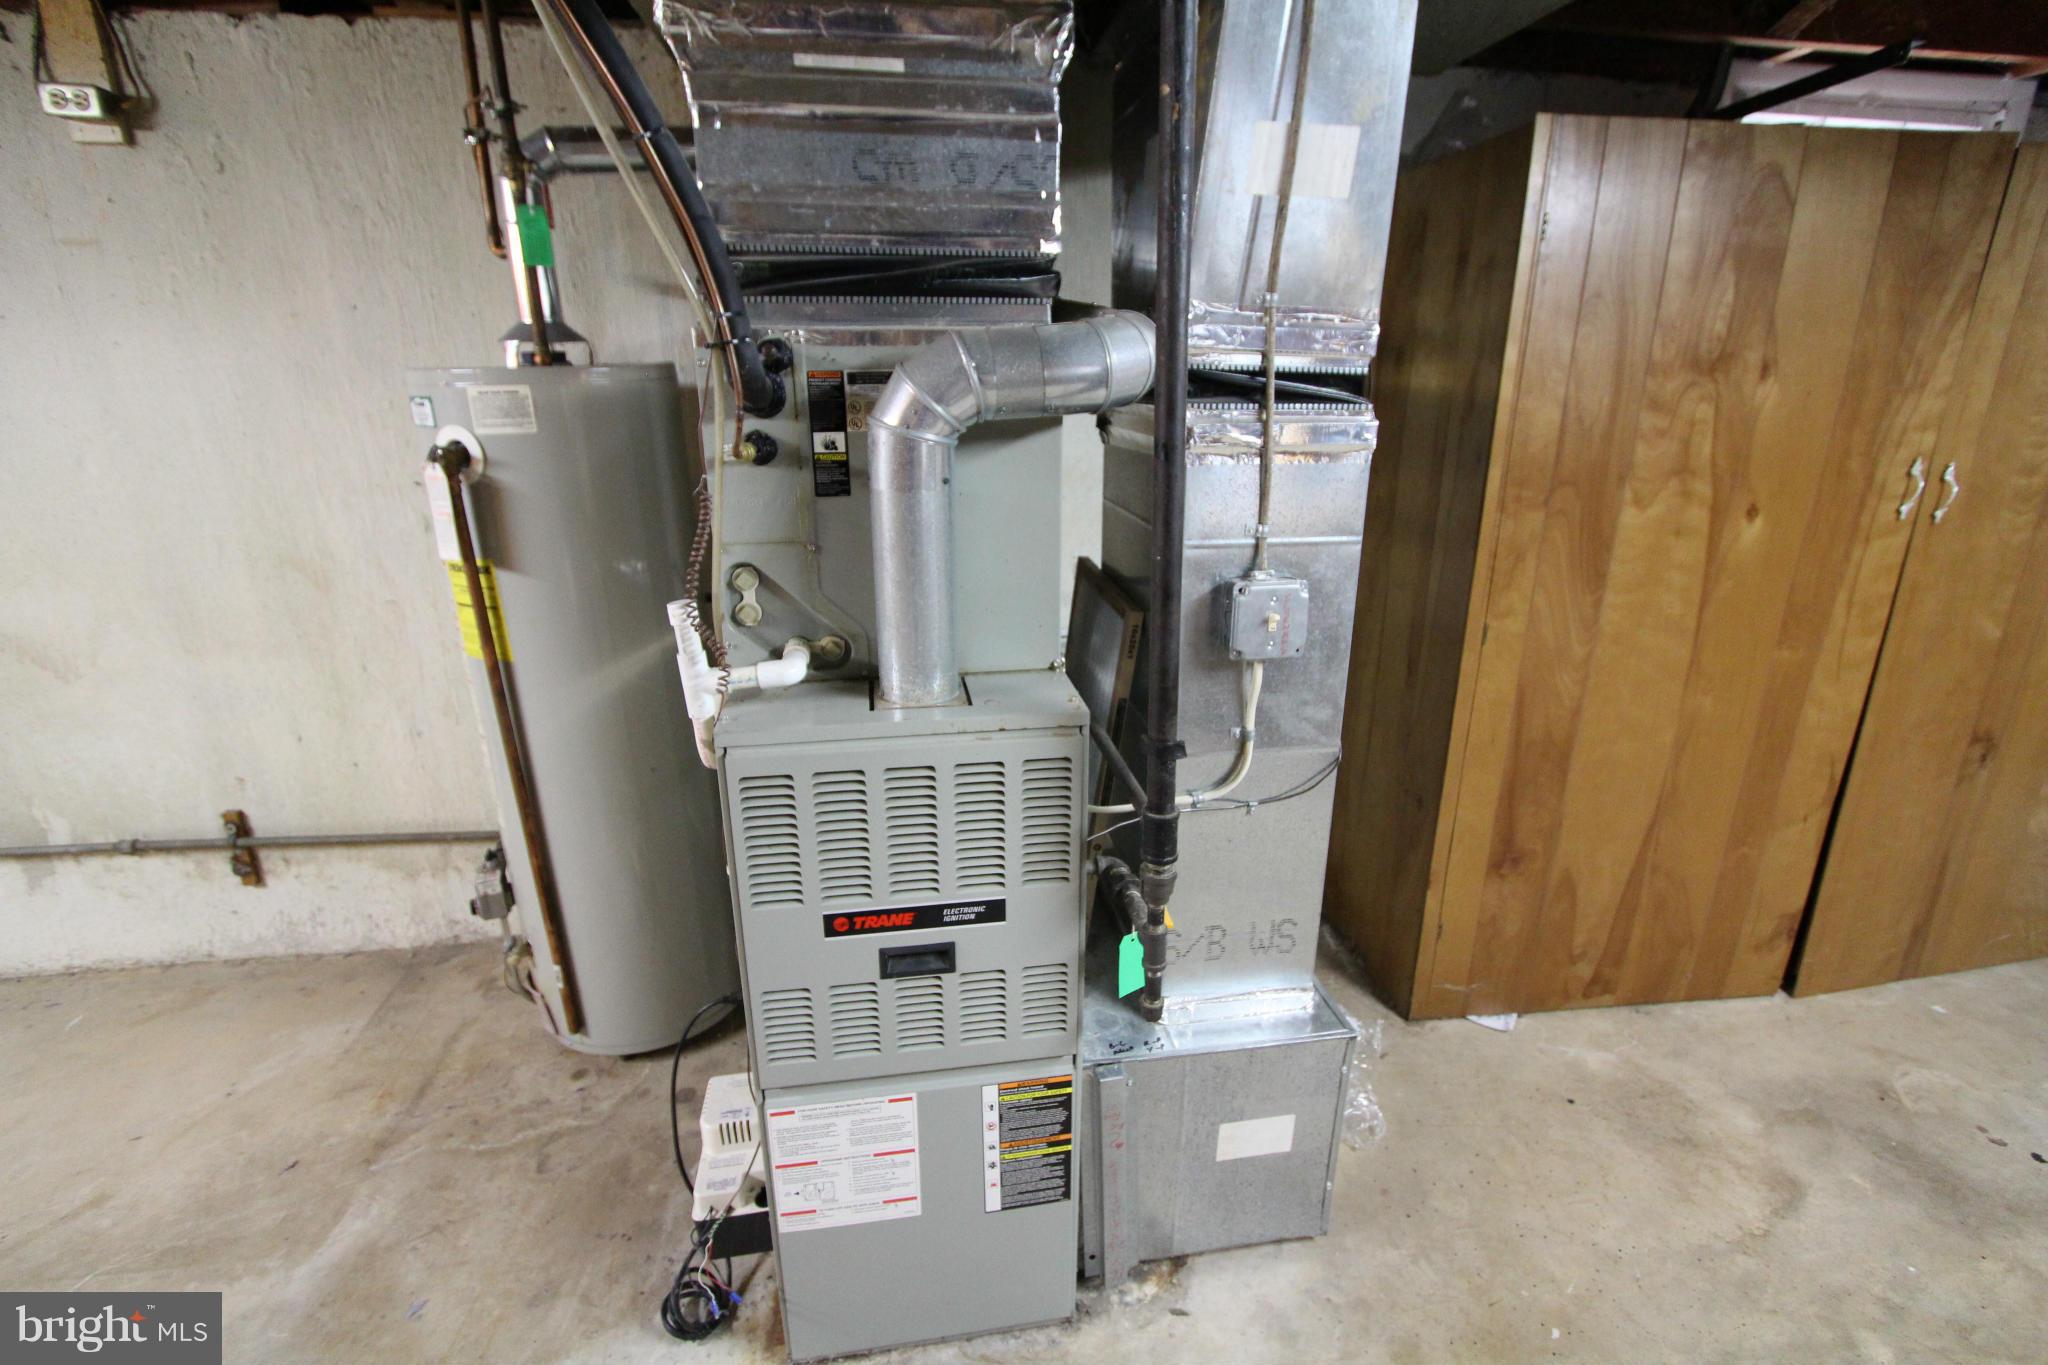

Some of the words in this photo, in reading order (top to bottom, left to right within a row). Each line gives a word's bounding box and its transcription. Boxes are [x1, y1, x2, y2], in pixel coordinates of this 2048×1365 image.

[853, 912, 914, 930] TRANE
[943, 905, 986, 915] ELECTRONIC
[943, 913, 976, 922] IGNITION
